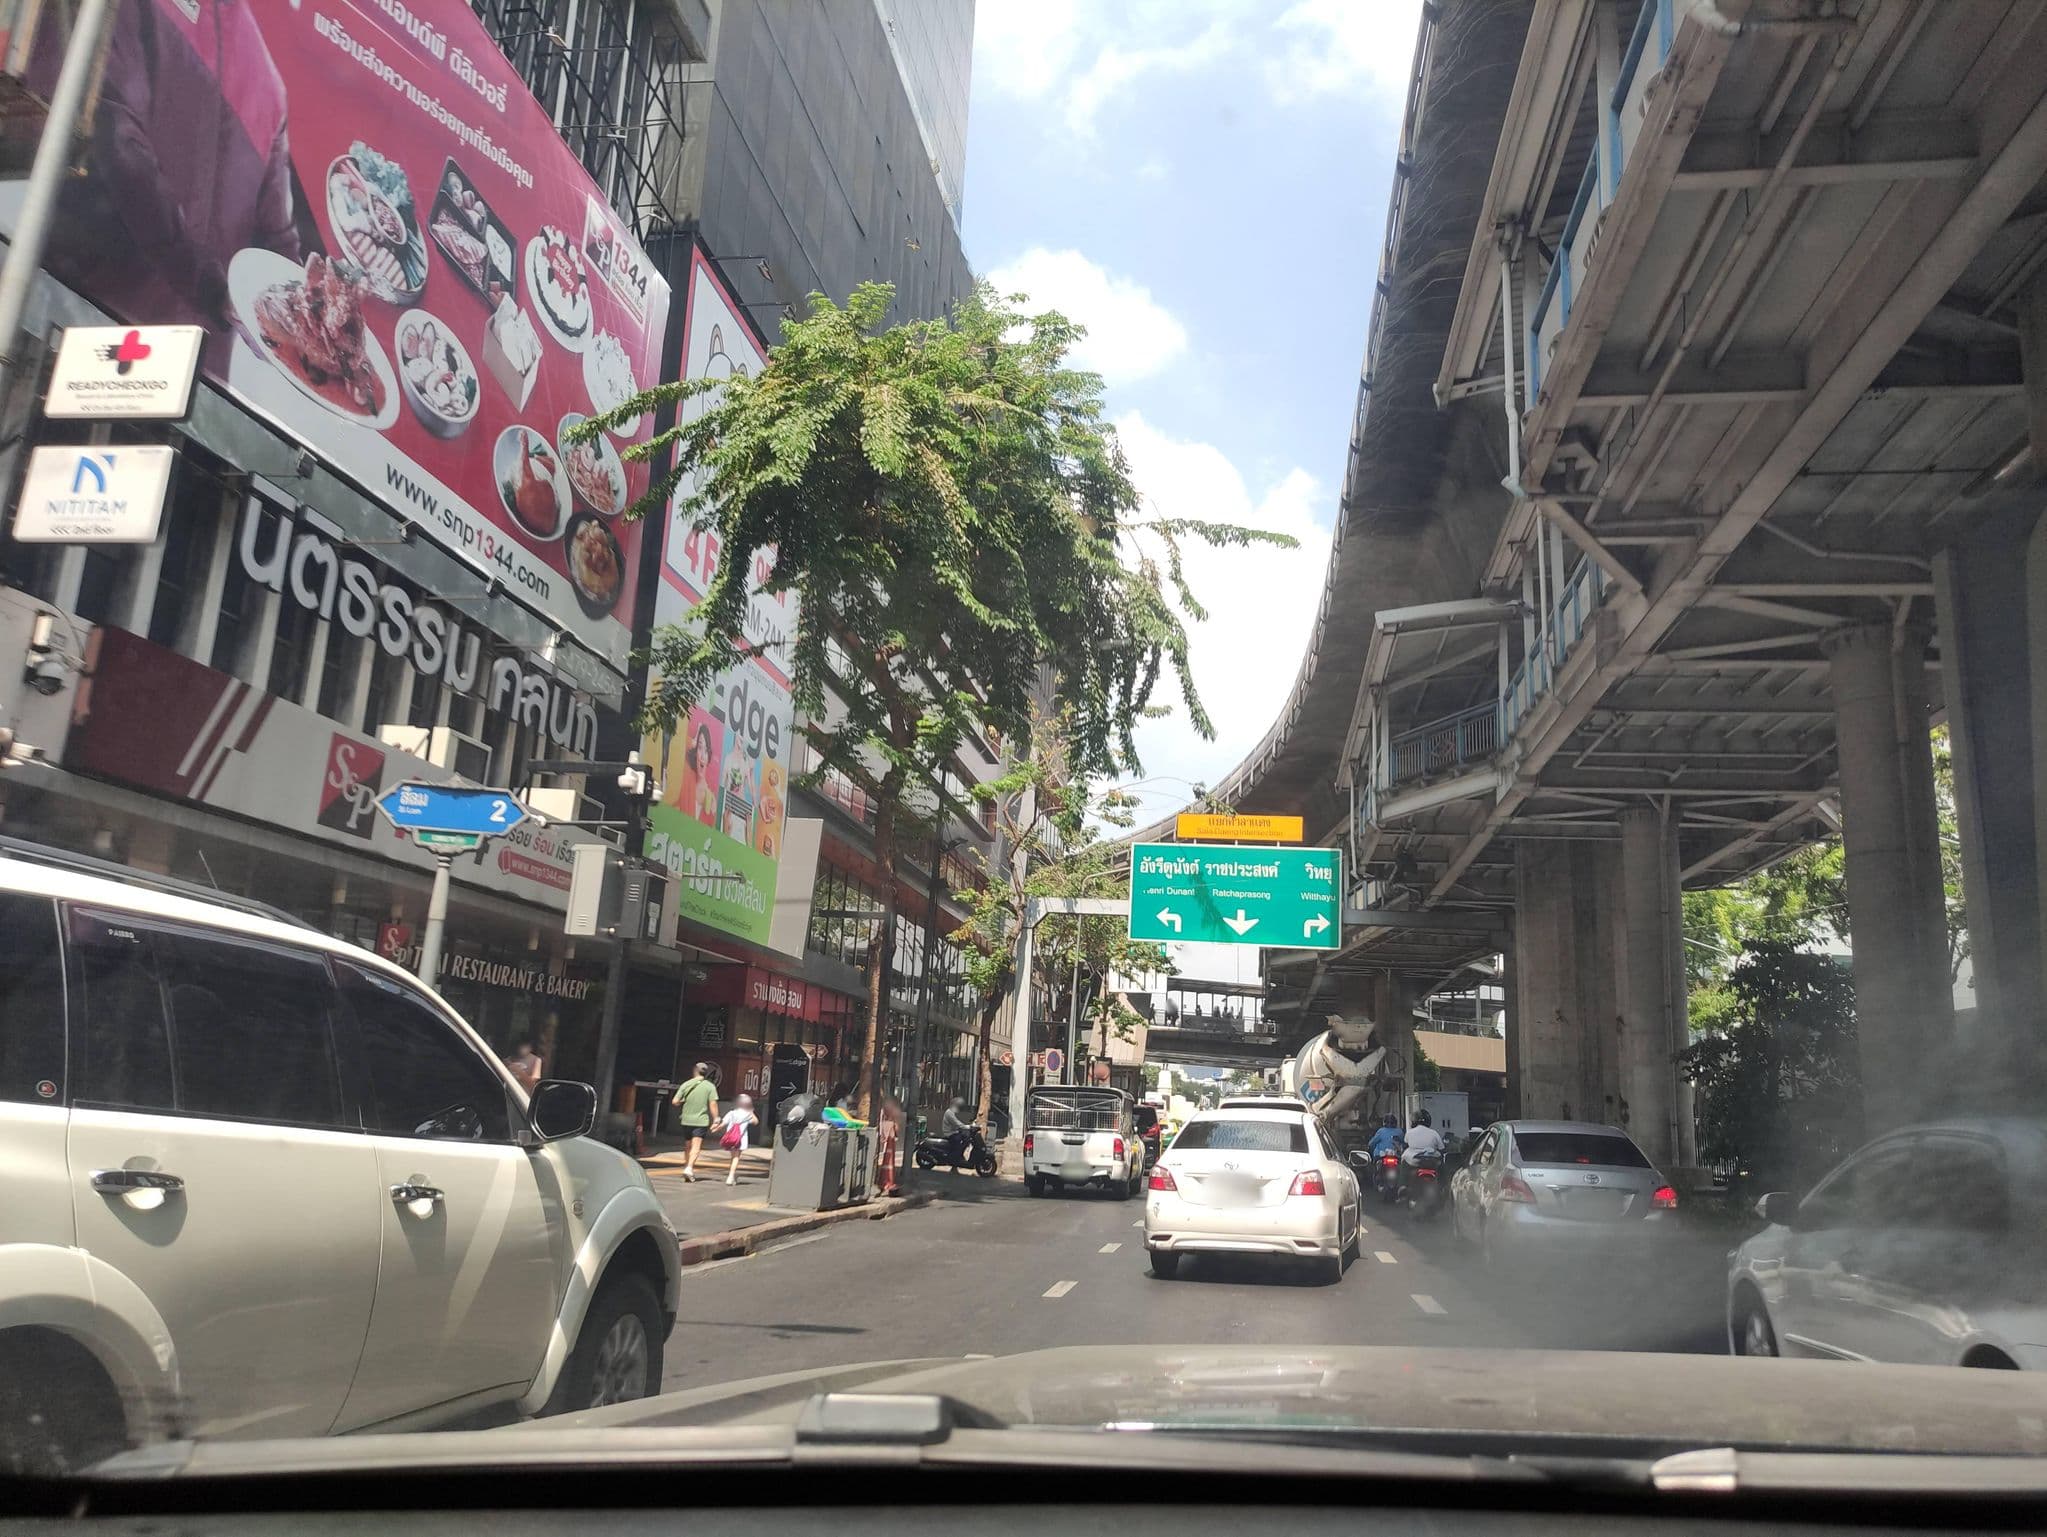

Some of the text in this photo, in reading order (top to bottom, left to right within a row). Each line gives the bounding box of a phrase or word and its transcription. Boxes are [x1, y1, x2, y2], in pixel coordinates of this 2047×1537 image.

[374, 0, 507, 113] แอนด์พี ดีลิเวอรี่
[613, 240, 648, 299] 1344
[47, 500, 128, 514] NITITAM
[386, 462, 551, 601] www.snp1344.com
[487, 649, 599, 763] คลินิก
[489, 799, 507, 823] 2
[1139, 856, 1333, 885] อังรีดูนังต์ ราชประสงค์ วิทยุ
[1212, 888, 1271, 900] Ratchaprasong
[1301, 891, 1336, 903] Witthayu
[451, 954, 533, 991] RESTAURANT
[535, 972, 545, 993] &
[547, 975, 591, 1000] BAKERY
